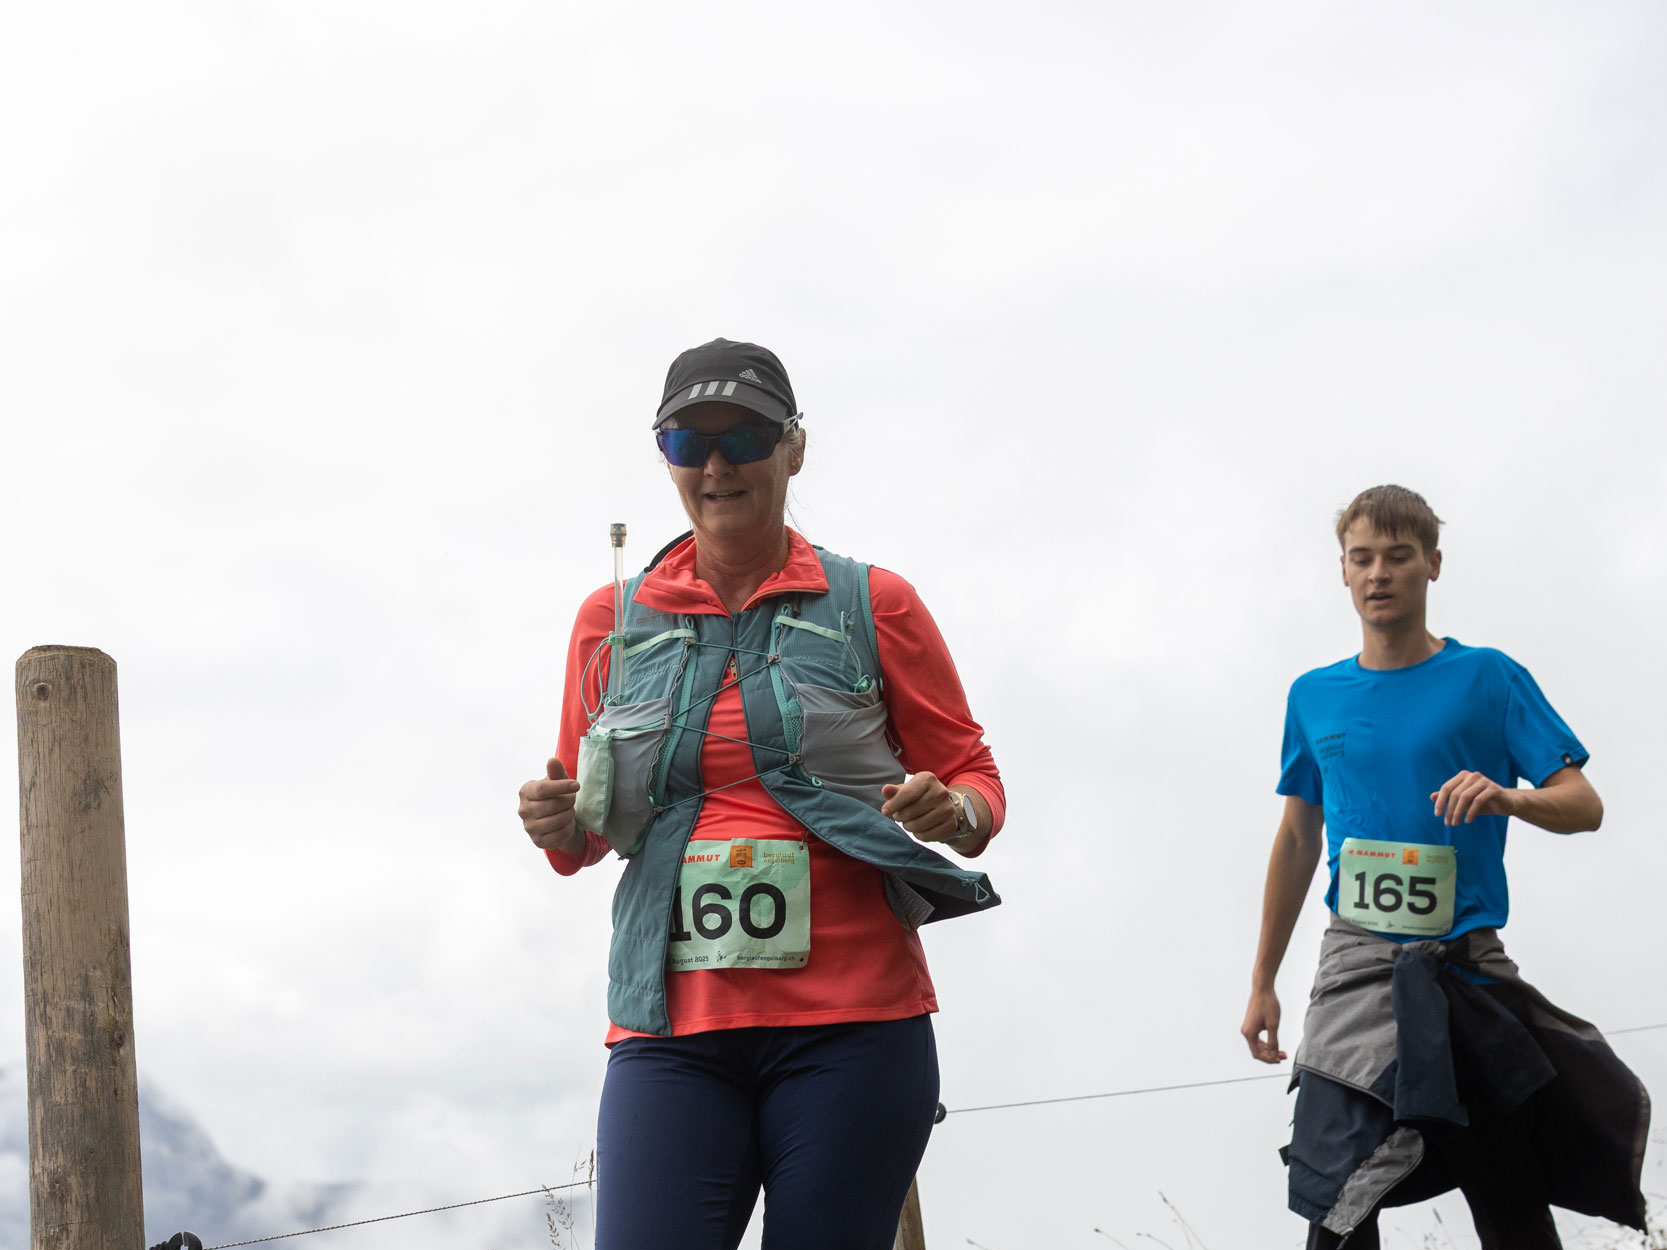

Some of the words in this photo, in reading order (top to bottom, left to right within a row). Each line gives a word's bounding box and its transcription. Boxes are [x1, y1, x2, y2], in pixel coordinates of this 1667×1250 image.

[681, 854, 721, 864] AMMUT
[1356, 850, 1396, 859] MAMMUT
[1353, 871, 1438, 916] 165
[669, 883, 786, 942] 160
[694, 955, 709, 963] 2025
